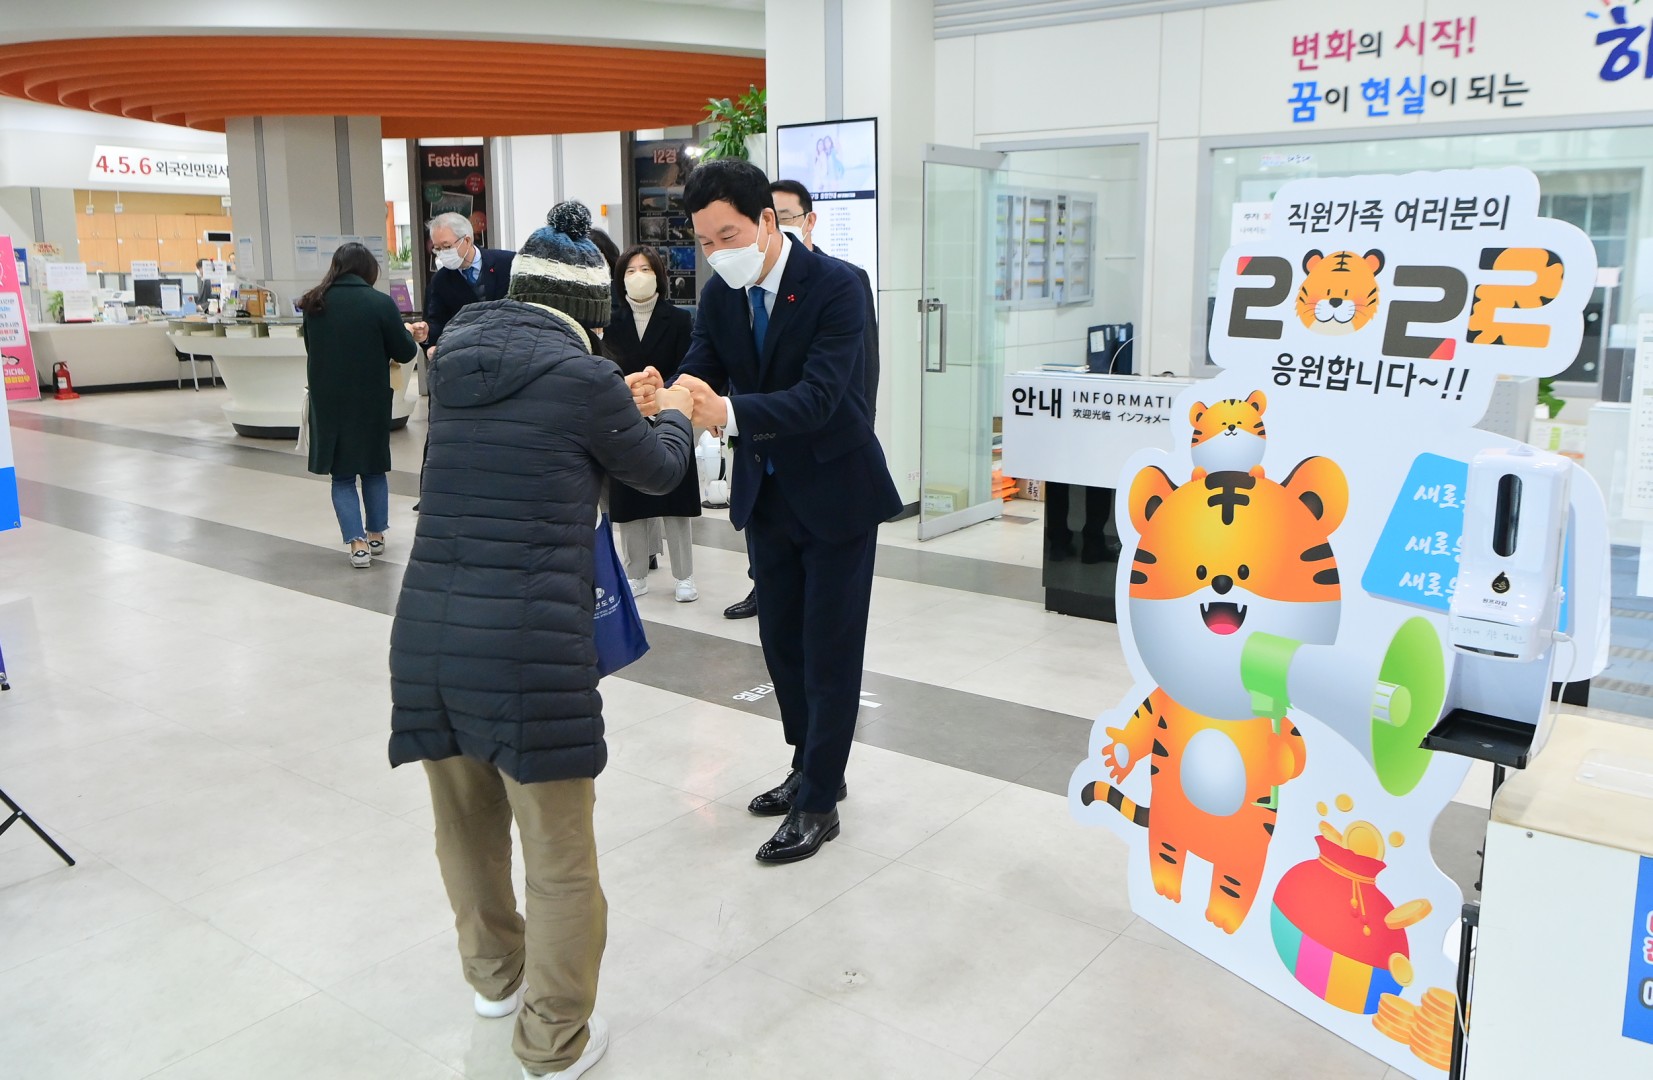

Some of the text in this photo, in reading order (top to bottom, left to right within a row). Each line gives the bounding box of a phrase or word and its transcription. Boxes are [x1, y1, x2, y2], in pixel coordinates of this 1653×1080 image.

[1292, 16, 1476, 71] 변화의 시작!
[1287, 73, 1530, 123] 꿈이 현실이 되는
[428, 153, 479, 168] Festival
[1287, 194, 1511, 234] 직원가족 여러분의
[1271, 352, 1470, 400] 응원합니다~!!
[1012, 386, 1172, 418] 안내 INFORMATI
[1072, 409, 1111, 420] 欢迎光临
[1413, 483, 1466, 509] 새로
[732, 682, 775, 702] 엘리
